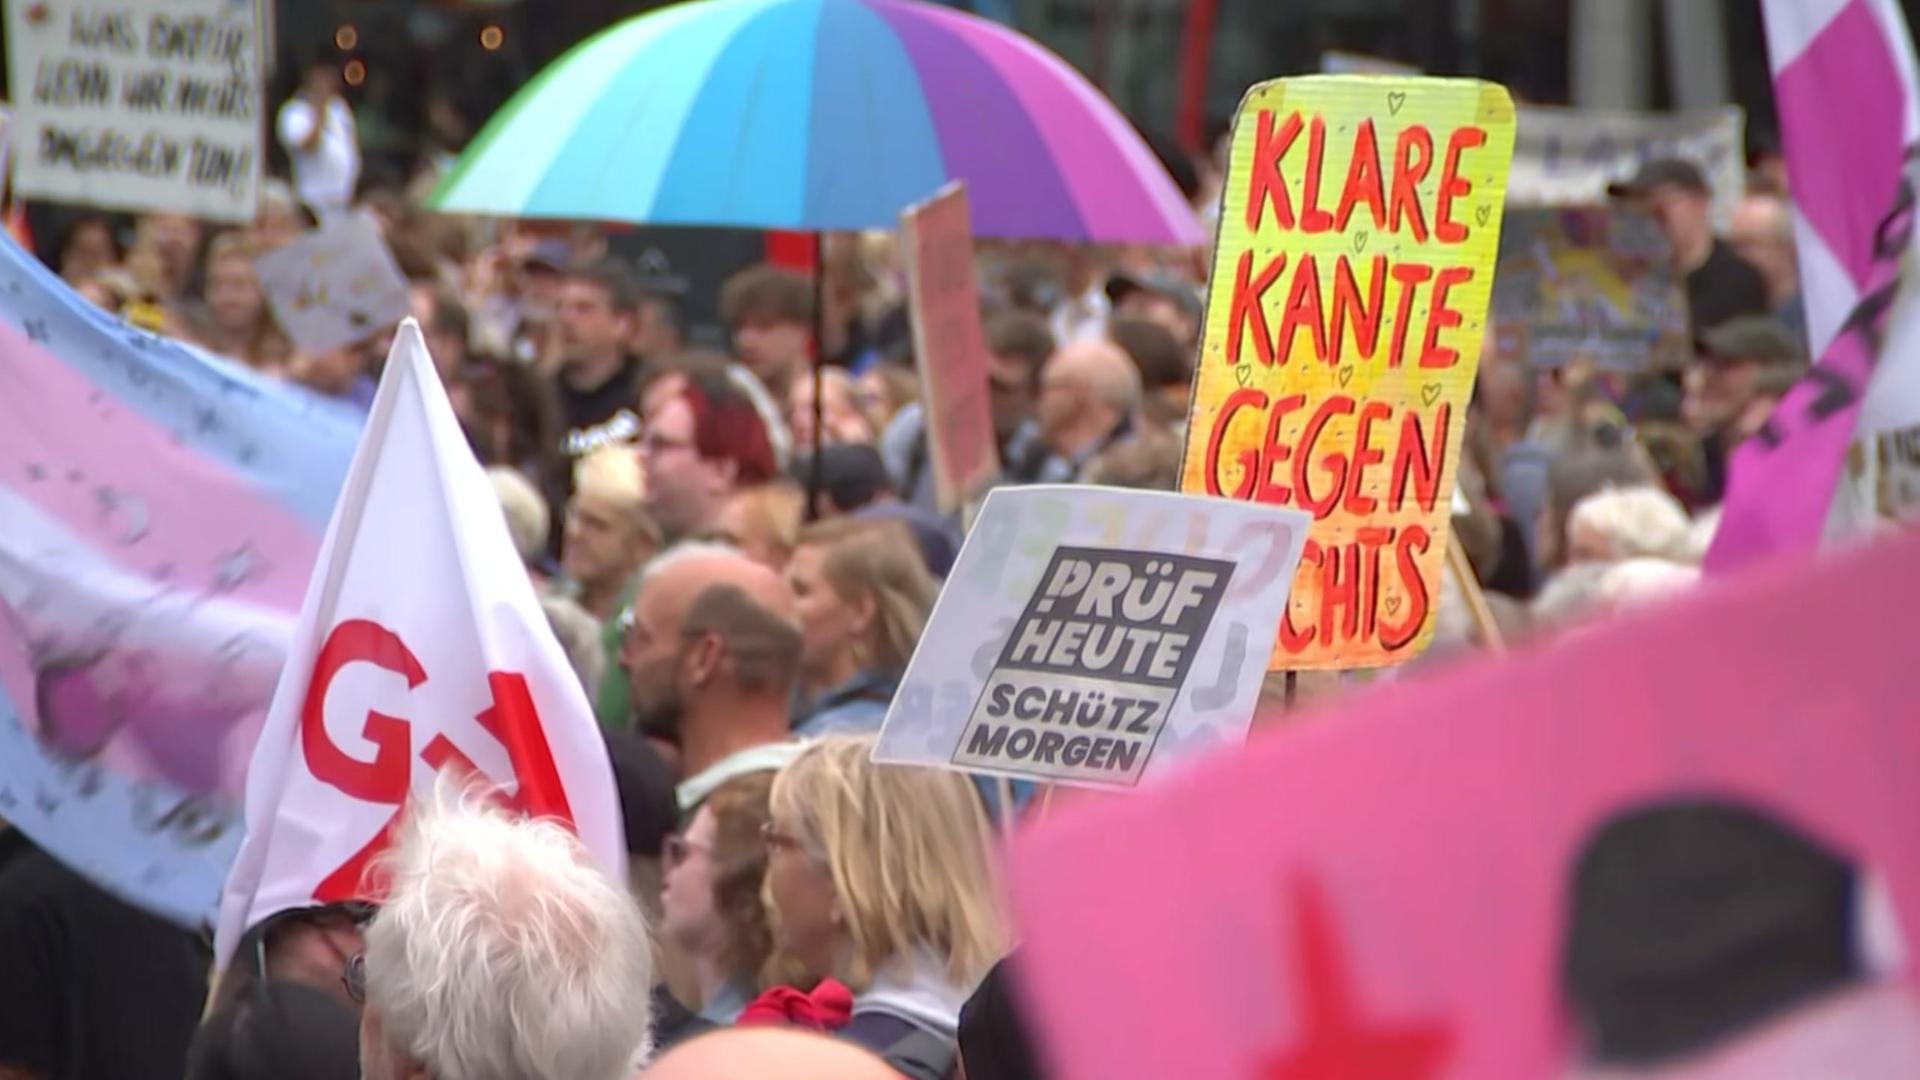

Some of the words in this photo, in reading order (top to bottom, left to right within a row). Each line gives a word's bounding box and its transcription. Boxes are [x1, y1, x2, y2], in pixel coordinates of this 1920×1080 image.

[1246, 109, 1487, 244] KLARE
[1226, 249, 1474, 368] KANTE
[1204, 388, 1450, 521] GEGEN
[1037, 559, 1217, 625] PRÜF
[1279, 524, 1431, 653] CHTS
[1011, 618, 1190, 680] HEUTE
[966, 724, 1141, 771] MORGEN
[986, 683, 1160, 734] SCHÜTZ
